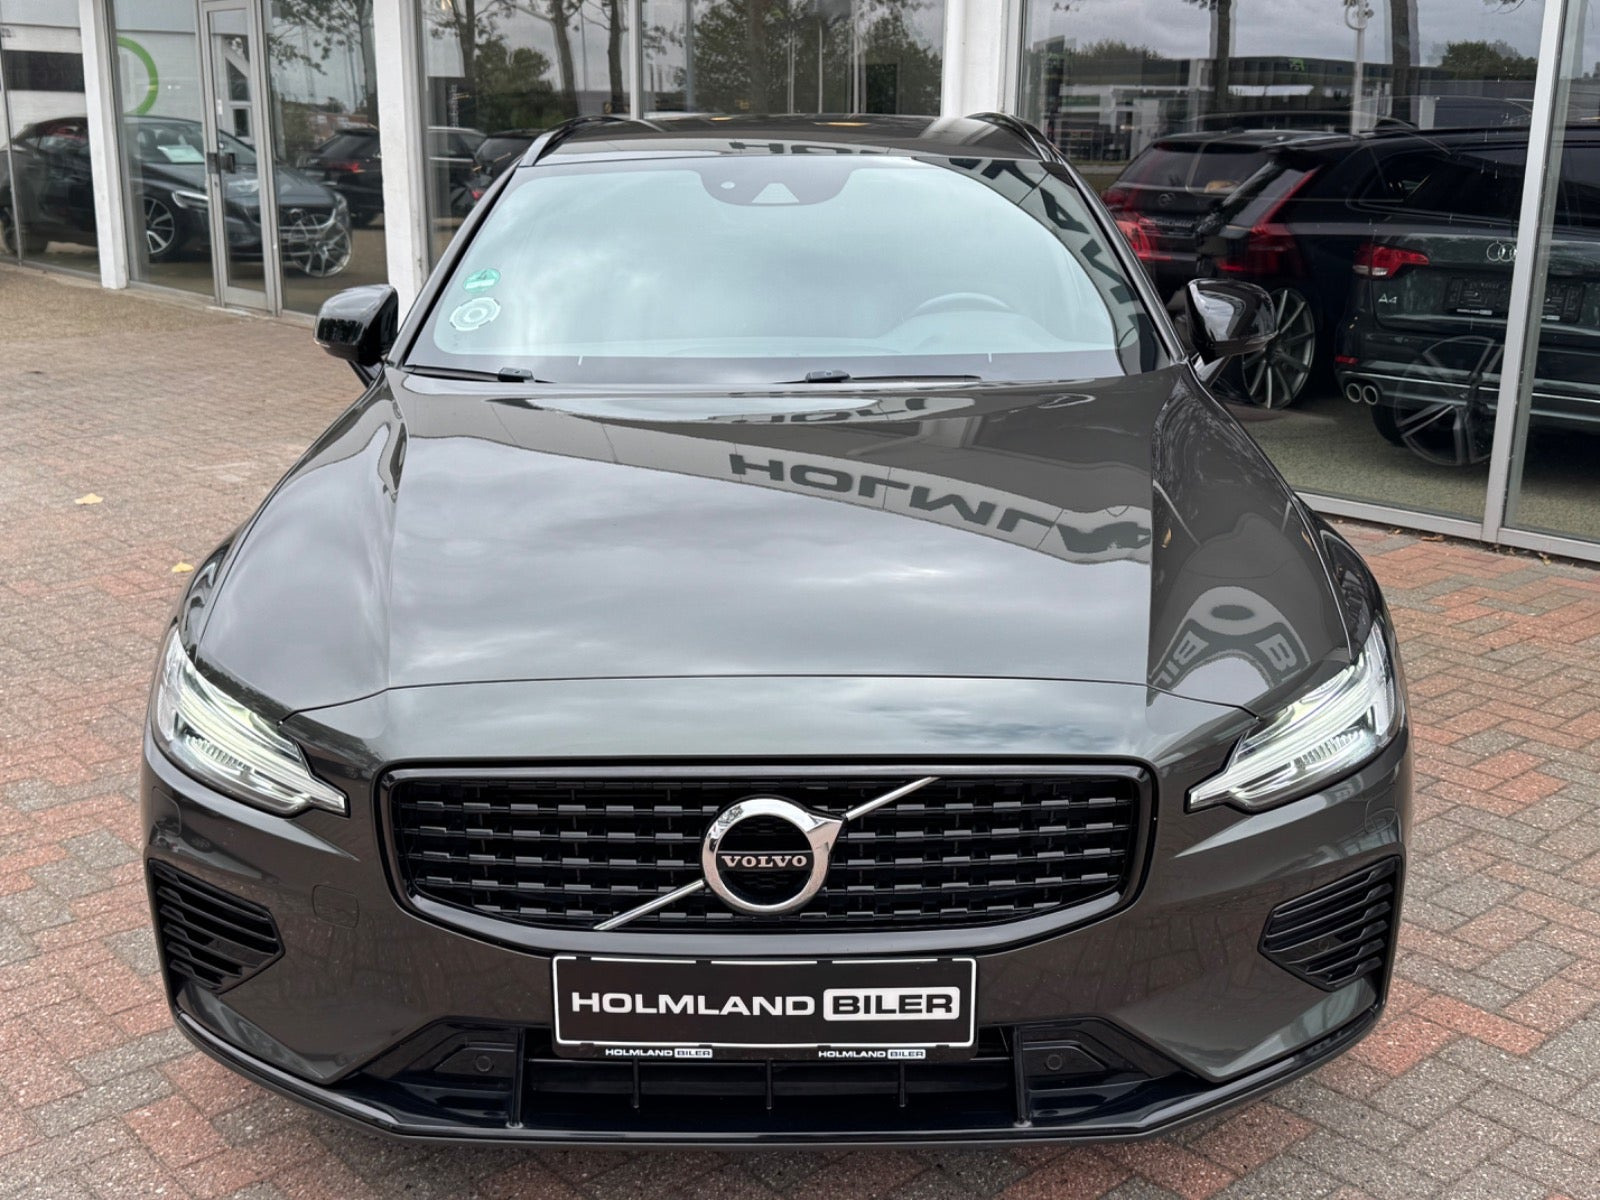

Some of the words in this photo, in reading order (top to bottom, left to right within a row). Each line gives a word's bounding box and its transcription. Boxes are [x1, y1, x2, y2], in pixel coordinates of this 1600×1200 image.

[1378, 293, 1397, 304] A4
[721, 855, 807, 867] VOLVO
[571, 991, 814, 1016] HOLMLAND
[832, 994, 953, 1015] BILER
[605, 1048, 673, 1057] HOLMLAND
[676, 1049, 712, 1058] BILER
[818, 1050, 886, 1058] HOLMLAND
[889, 1050, 925, 1058] BILER
